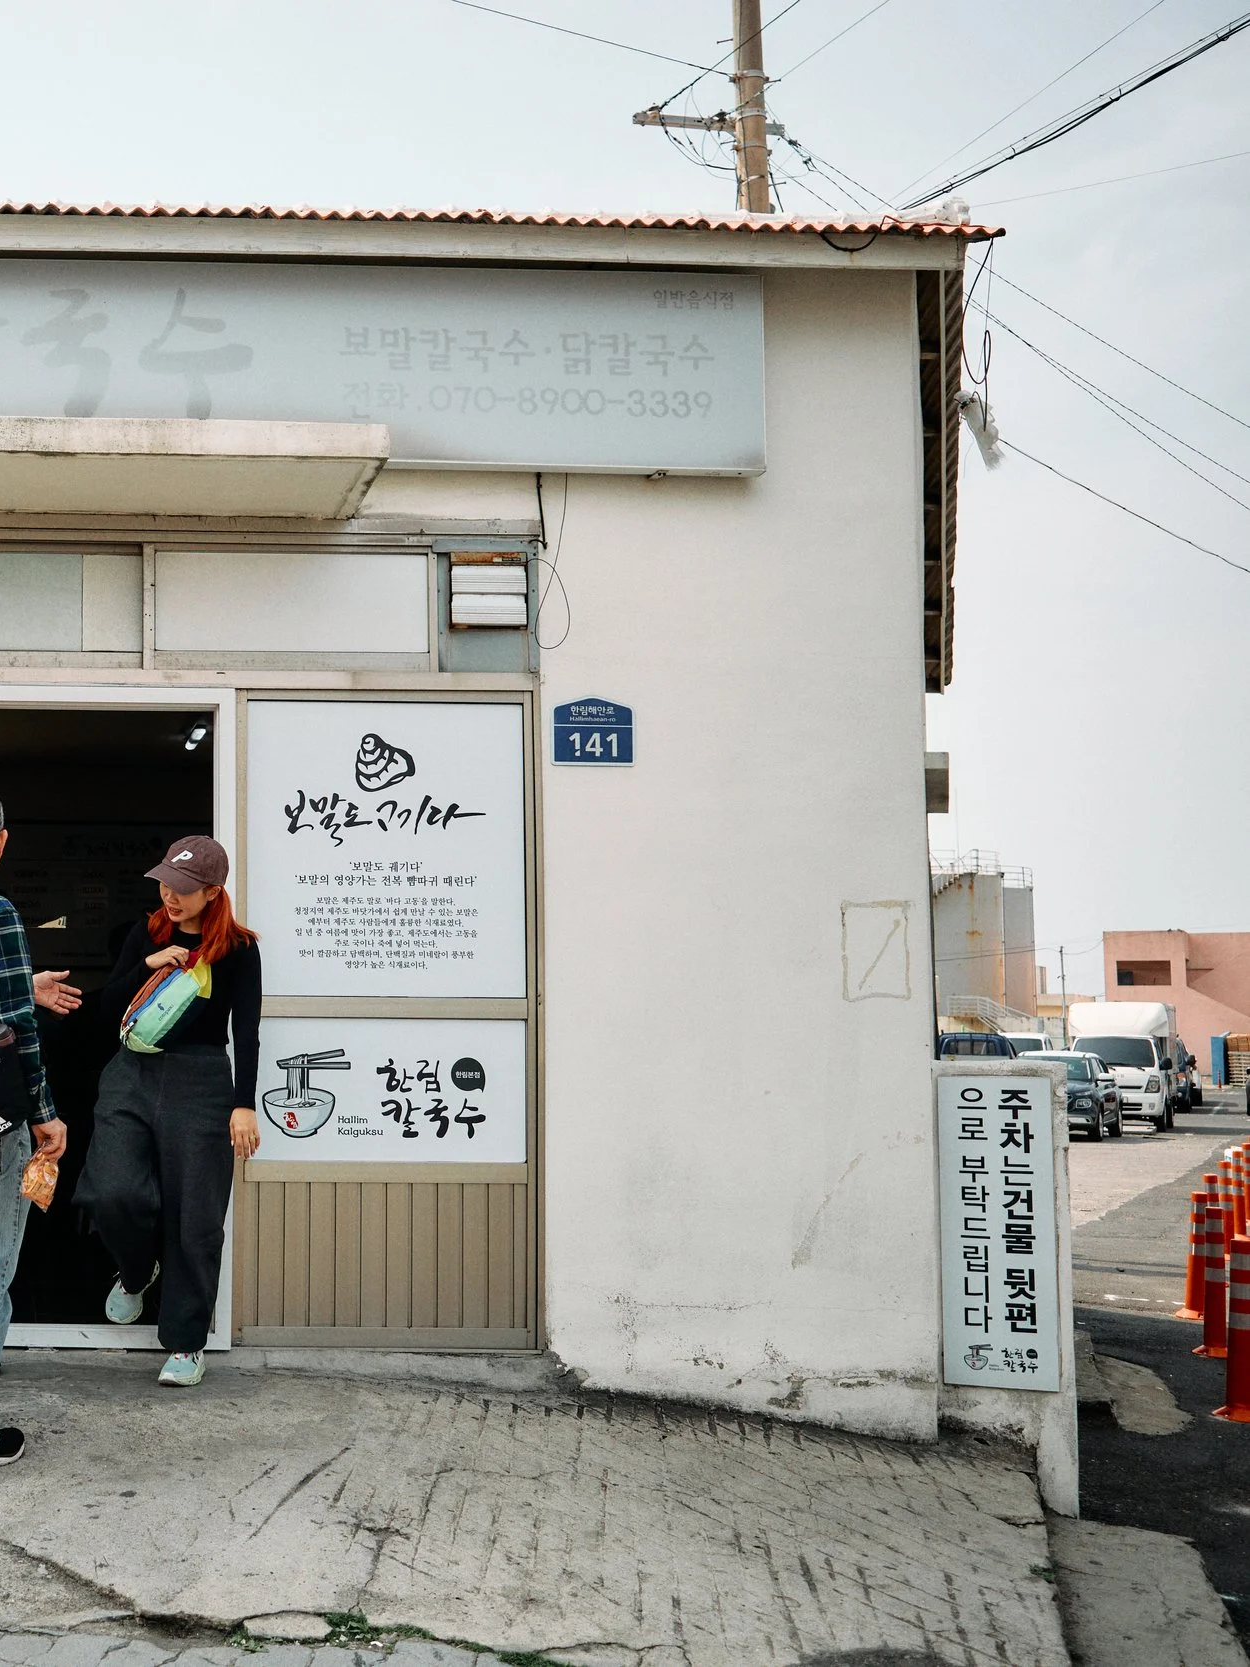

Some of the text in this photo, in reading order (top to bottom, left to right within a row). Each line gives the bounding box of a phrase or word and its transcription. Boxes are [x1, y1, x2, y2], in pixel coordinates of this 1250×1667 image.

[653, 289, 735, 311] 일반음식점
[570, 705, 615, 717] 한림해안로
[569, 732, 618, 757] 141
[334, 874, 377, 887] 영양가는
[382, 875, 403, 887] 전복
[316, 896, 339, 905] 보말은
[342, 896, 364, 905] 제주도
[294, 906, 479, 917] 청정지역 제주도 바닷가에서 쉽게 만날 수 있는 보말은
[333, 918, 356, 926] 제주도
[358, 918, 396, 927] 사람들에게
[305, 928, 313, 936] 년
[315, 928, 323, 937] 중
[325, 928, 349, 937] 여름에
[351, 928, 366, 937] 맛이
[369, 928, 384, 938] 가장
[408, 929, 453, 938] 제주도에서는
[455, 929, 478, 938] 고동을
[334, 939, 350, 947] 주로
[352, 939, 375, 947] 국이나
[395, 940, 410, 948] 넣어
[299, 949, 314, 958] 맛이
[344, 960, 368, 969] 영양가
[376, 1058, 441, 1094] 한림
[455, 1070, 481, 1079] 한림본점
[337, 1115, 368, 1125] Hallim
[381, 1098, 486, 1139] 칼국수
[337, 1127, 384, 1138] Kalguksu
[959, 1155, 993, 1334] 부탁드립니다
[1003, 1268, 1038, 1334] 뒷편
[1001, 1348, 1023, 1359] 한림
[1003, 1360, 1038, 1374] 칼국수
